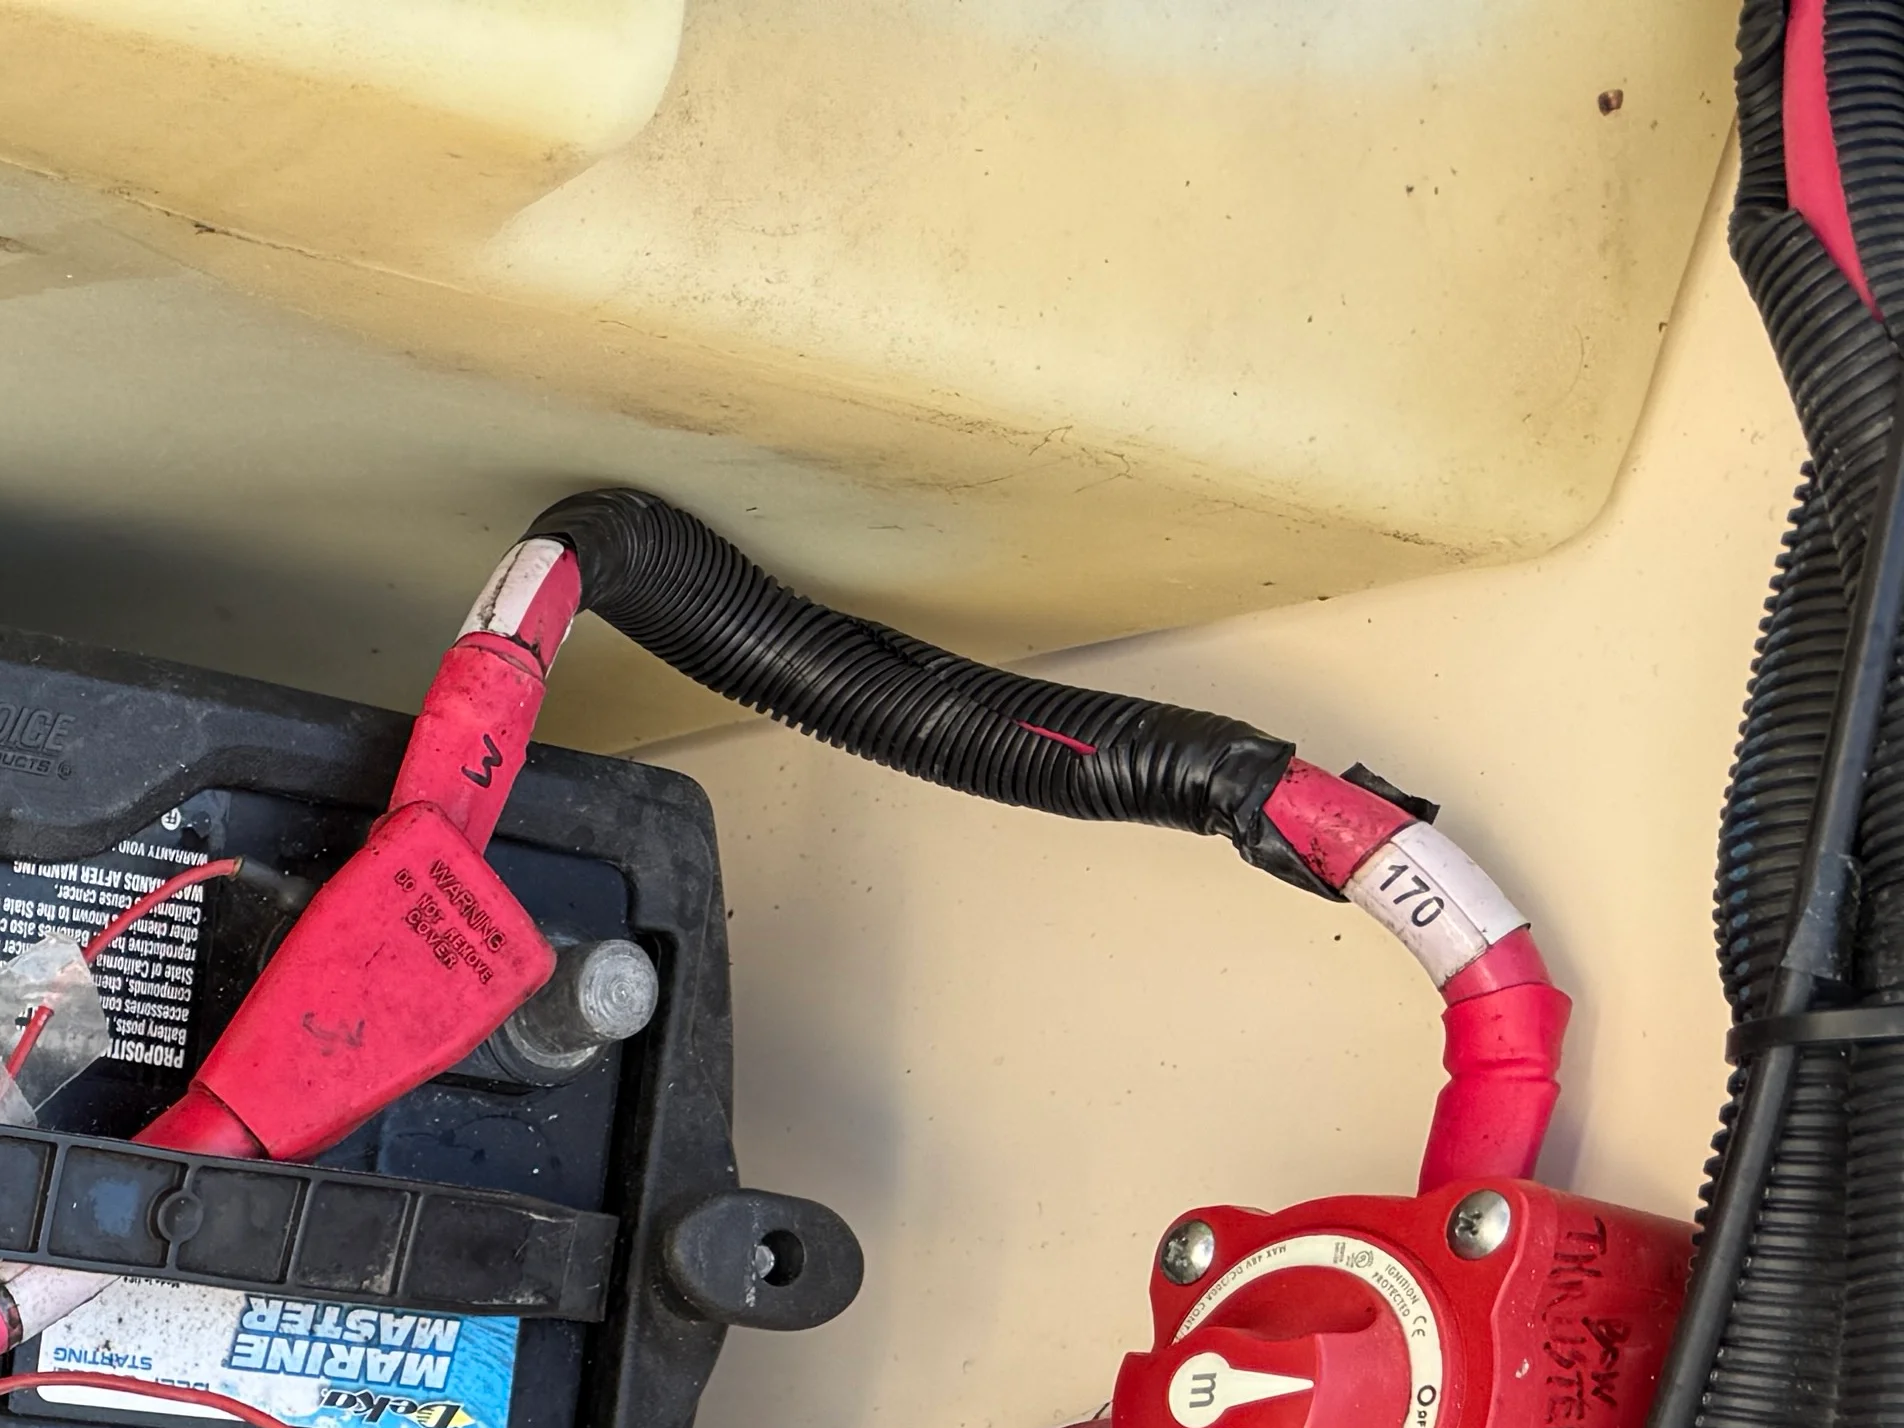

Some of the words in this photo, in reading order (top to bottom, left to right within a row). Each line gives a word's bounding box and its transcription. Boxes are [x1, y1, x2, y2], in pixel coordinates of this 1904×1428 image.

[146, 843, 209, 866] WARRANTY
[80, 867, 122, 888] AFTER
[54, 883, 97, 904] cancer.
[98, 890, 133, 910] cause
[430, 858, 507, 953] WARNING
[1378, 862, 1444, 929] 170
[2, 897, 35, 919] State
[36, 902, 56, 920] the
[71, 906, 110, 930] known
[8, 917, 36, 937] also
[169, 923, 199, 943] other
[394, 868, 417, 893] DO
[417, 892, 445, 925] NOT
[444, 927, 494, 985] REMOVE
[405, 907, 459, 970] COVER
[128, 934, 197, 962] reproductive
[95, 951, 149, 973] California
[164, 965, 194, 985] State
[125, 976, 192, 1002] compounds,
[123, 1000, 190, 1022] accessories
[112, 1017, 145, 1037] posts,
[146, 1022, 187, 1046] Battery
[1371, 1271, 1411, 1318] PROTECTED
[1383, 1263, 1422, 1306] IGNITION
[241, 1294, 462, 1353] MASTER
[52, 1346, 153, 1370] STARTING
[227, 1332, 454, 1390] MARINE
